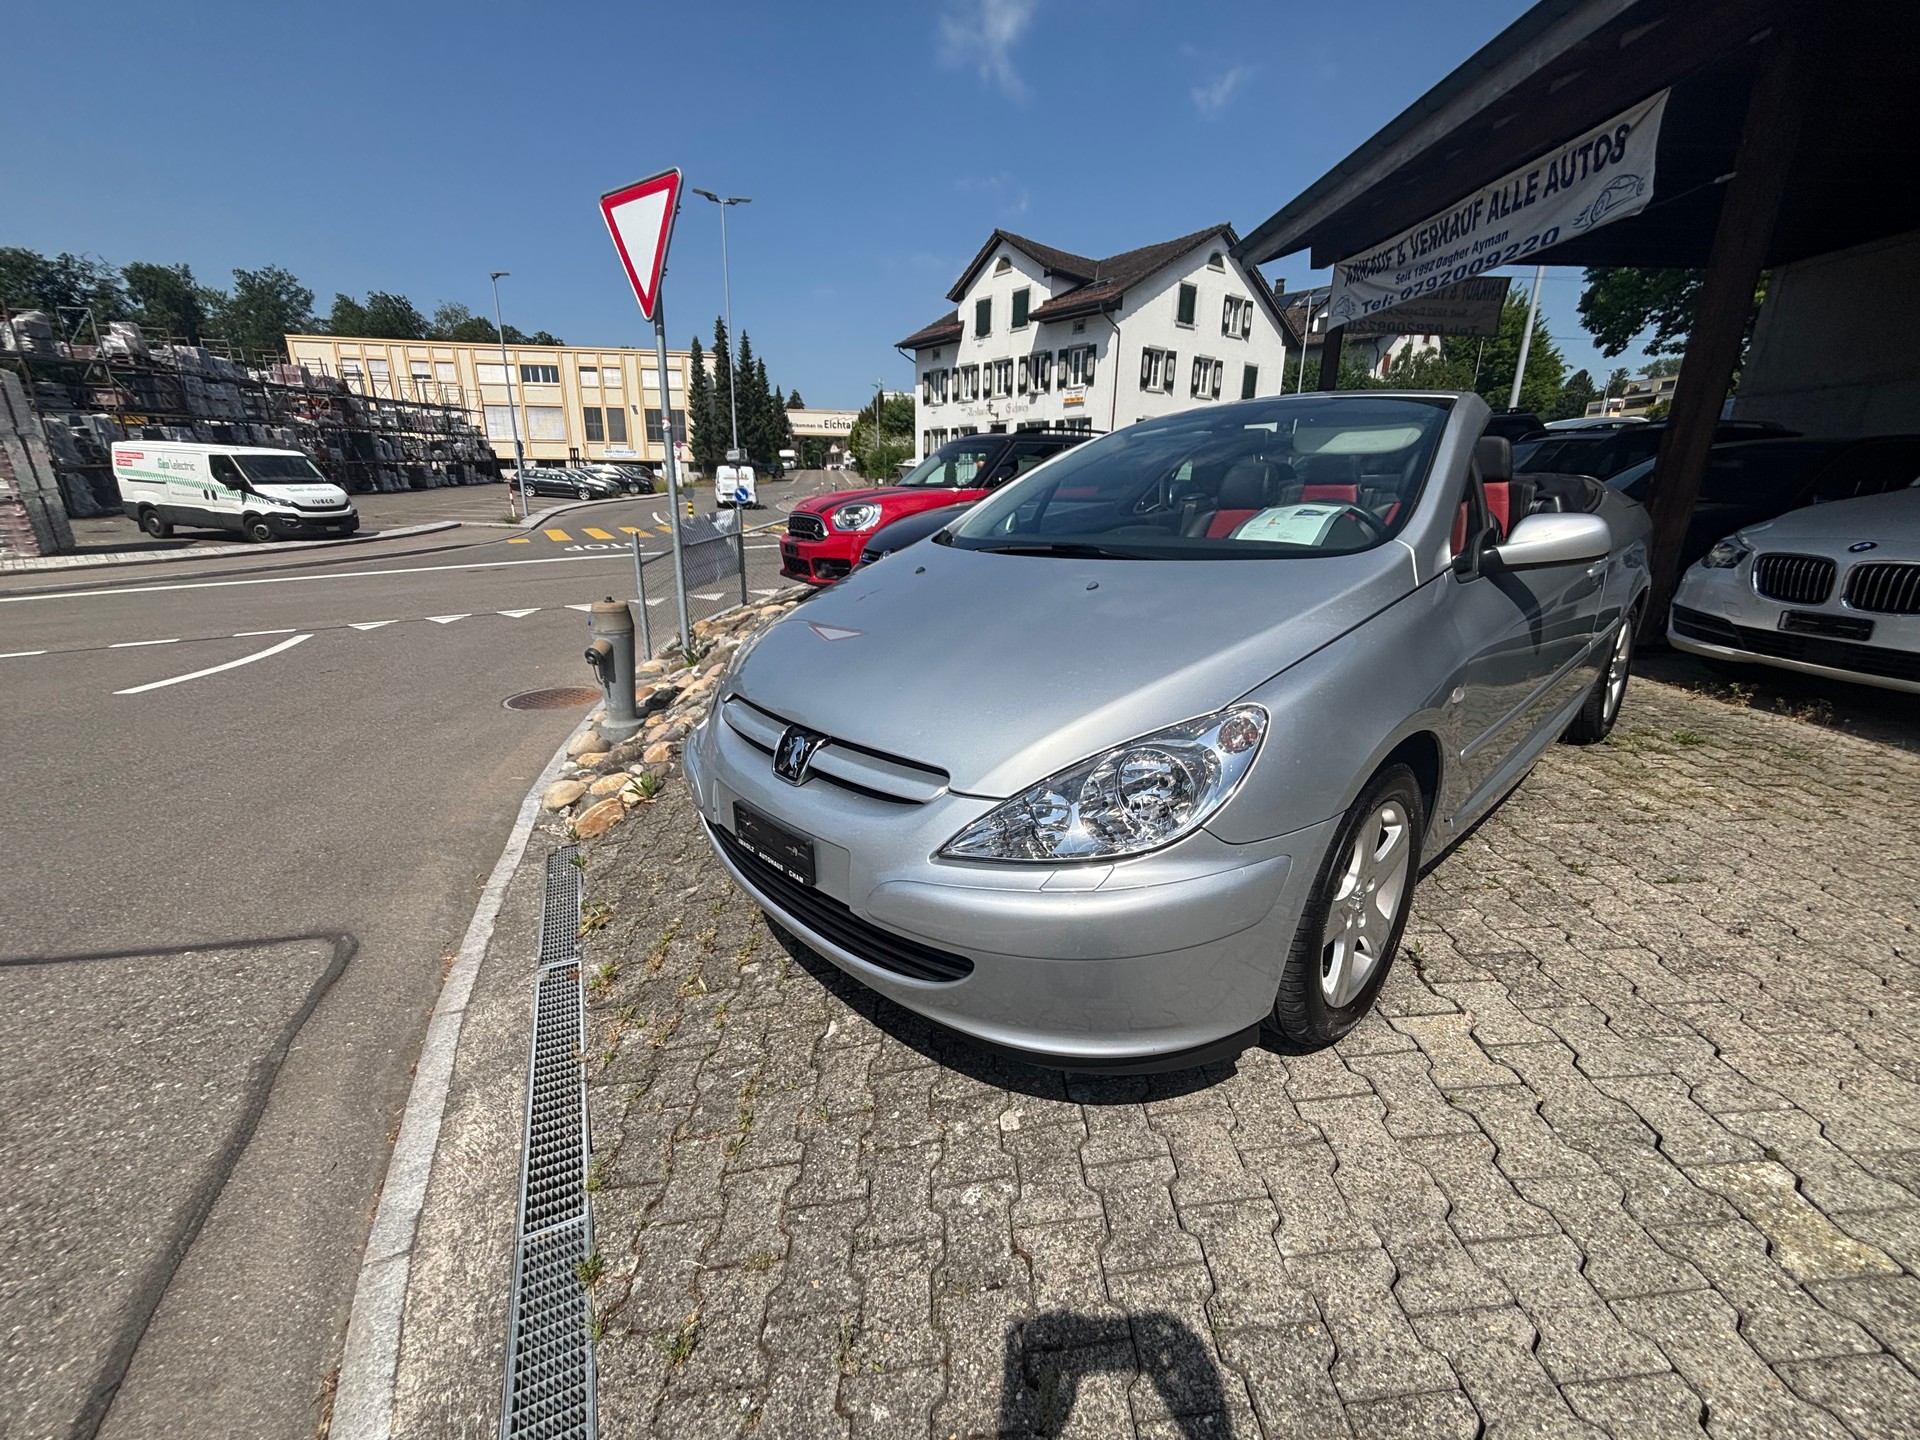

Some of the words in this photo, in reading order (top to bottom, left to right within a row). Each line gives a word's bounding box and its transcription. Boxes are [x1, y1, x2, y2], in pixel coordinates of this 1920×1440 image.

[1345, 248, 1392, 287] ANKAUF
[1397, 242, 1406, 268] &
[1410, 198, 1483, 260] VERKAUF
[1486, 170, 1539, 224] ALLE
[1543, 123, 1630, 198] AUTOS
[1362, 294, 1394, 314] Tel:
[1401, 226, 1560, 301] 0792009220
[1396, 271, 1411, 285] Seit
[1414, 259, 1434, 278] 1992
[1435, 247, 1469, 269] Dagher
[1471, 230, 1509, 254] Ayman
[759, 852, 783, 871] AUTOHAUS
[788, 870, 803, 883] CHAM
